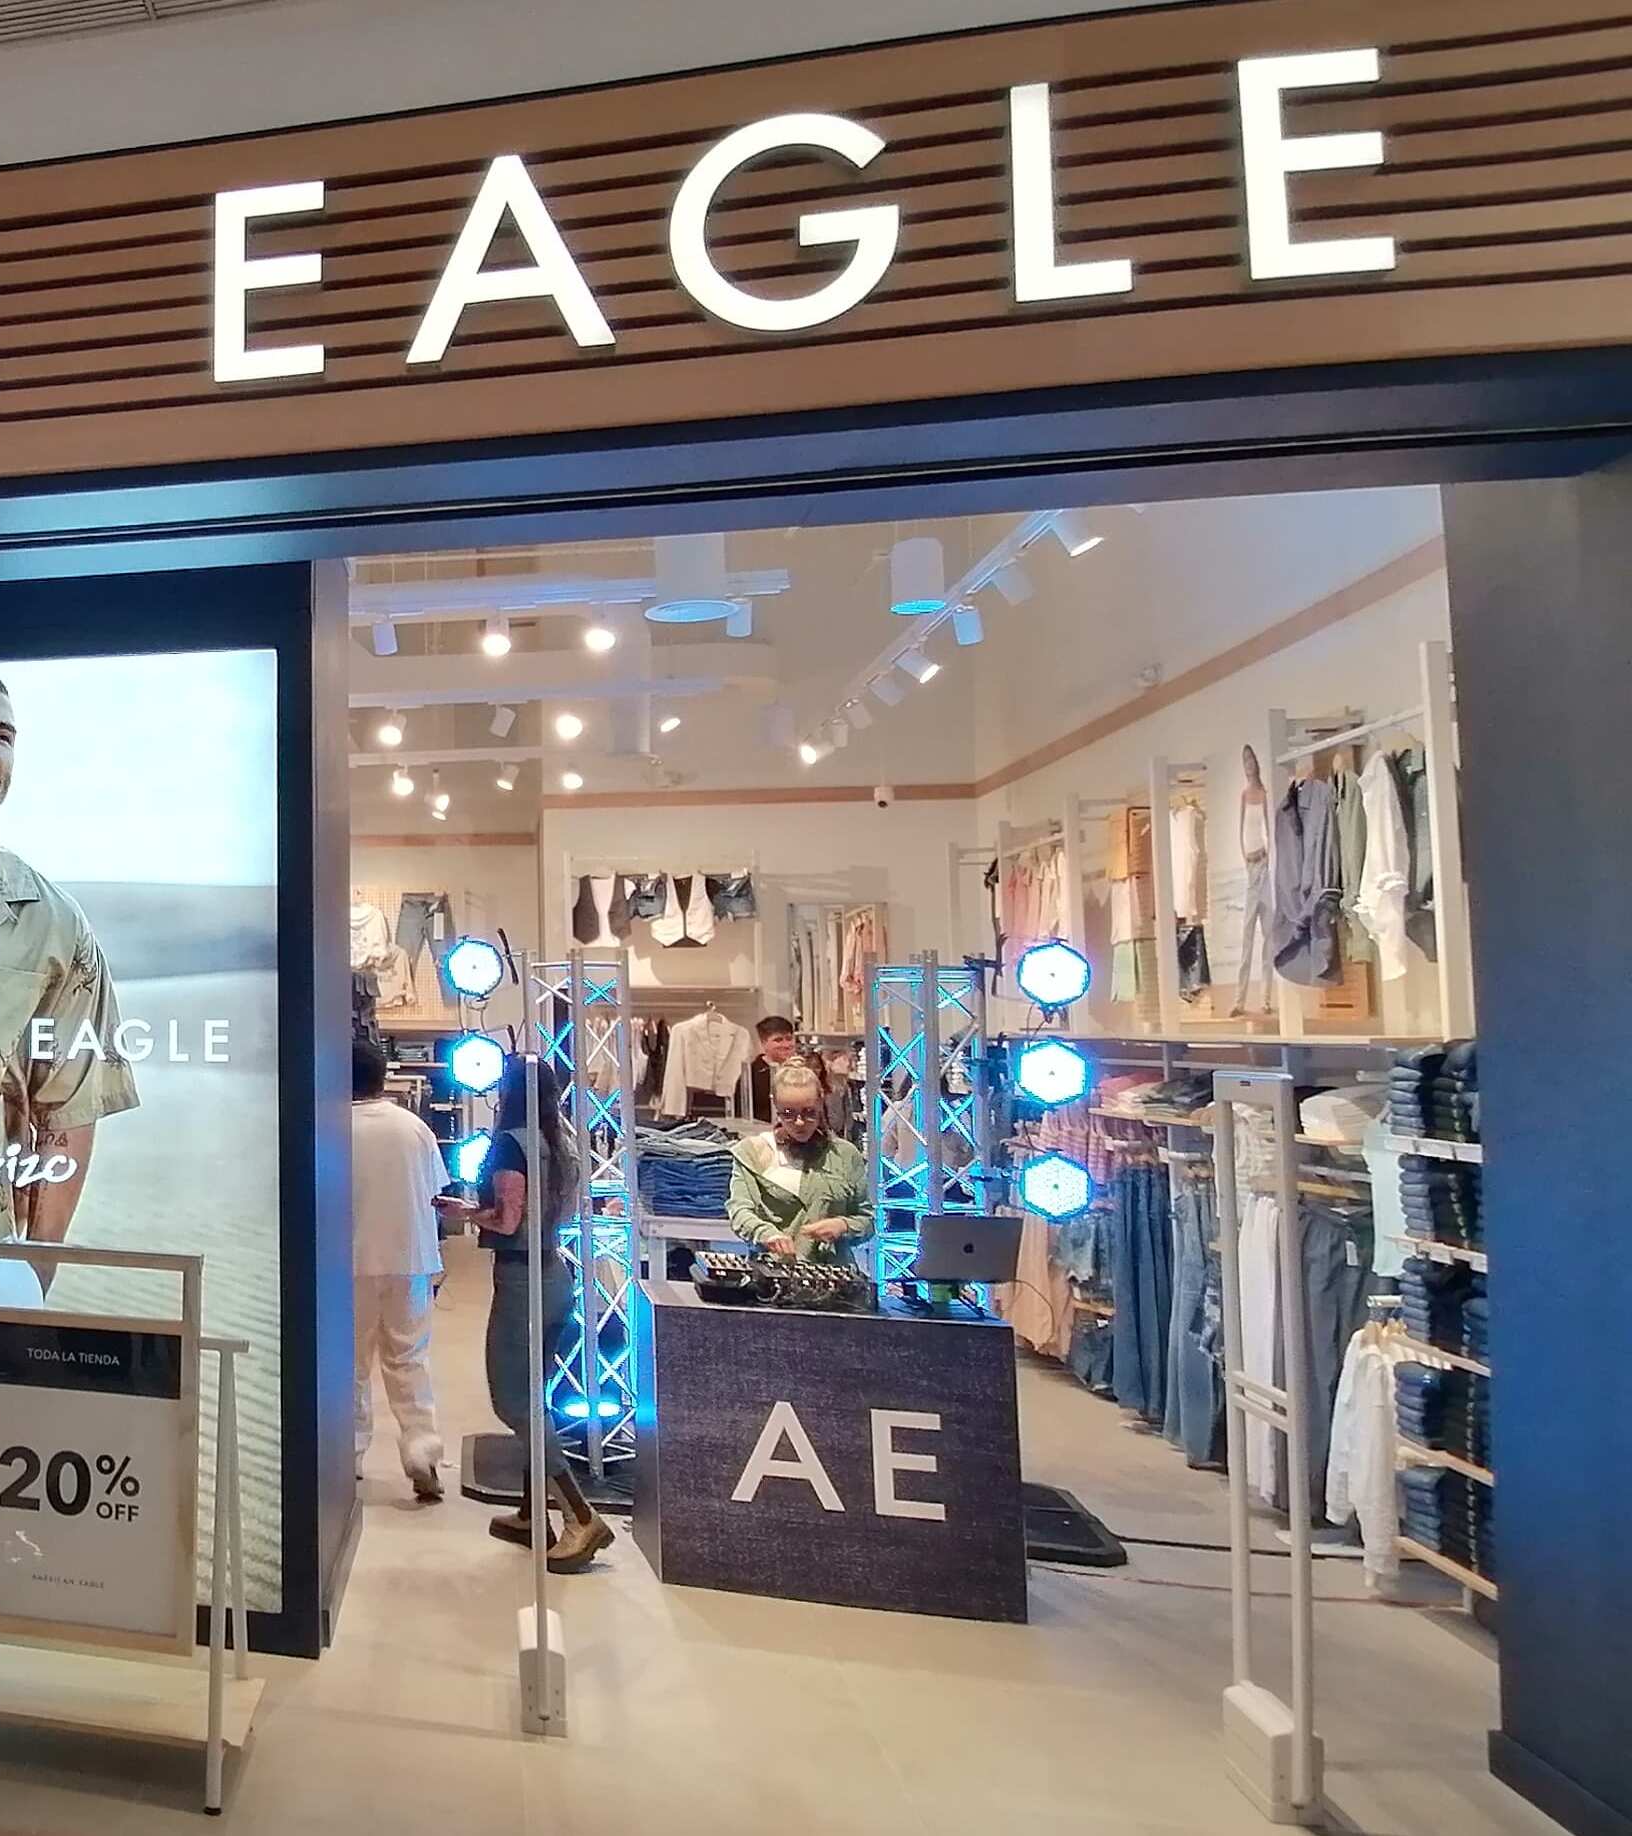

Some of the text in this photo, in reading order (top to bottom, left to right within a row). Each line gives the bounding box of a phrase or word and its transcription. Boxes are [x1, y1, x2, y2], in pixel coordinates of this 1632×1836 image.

[213, 48, 1395, 383] EAGLE
[30, 1018, 229, 1063] EAGLE
[27, 1347, 120, 1367] TODA LA TIENDA
[730, 1400, 946, 1521] AE
[95, 1501, 140, 1523] OFF
